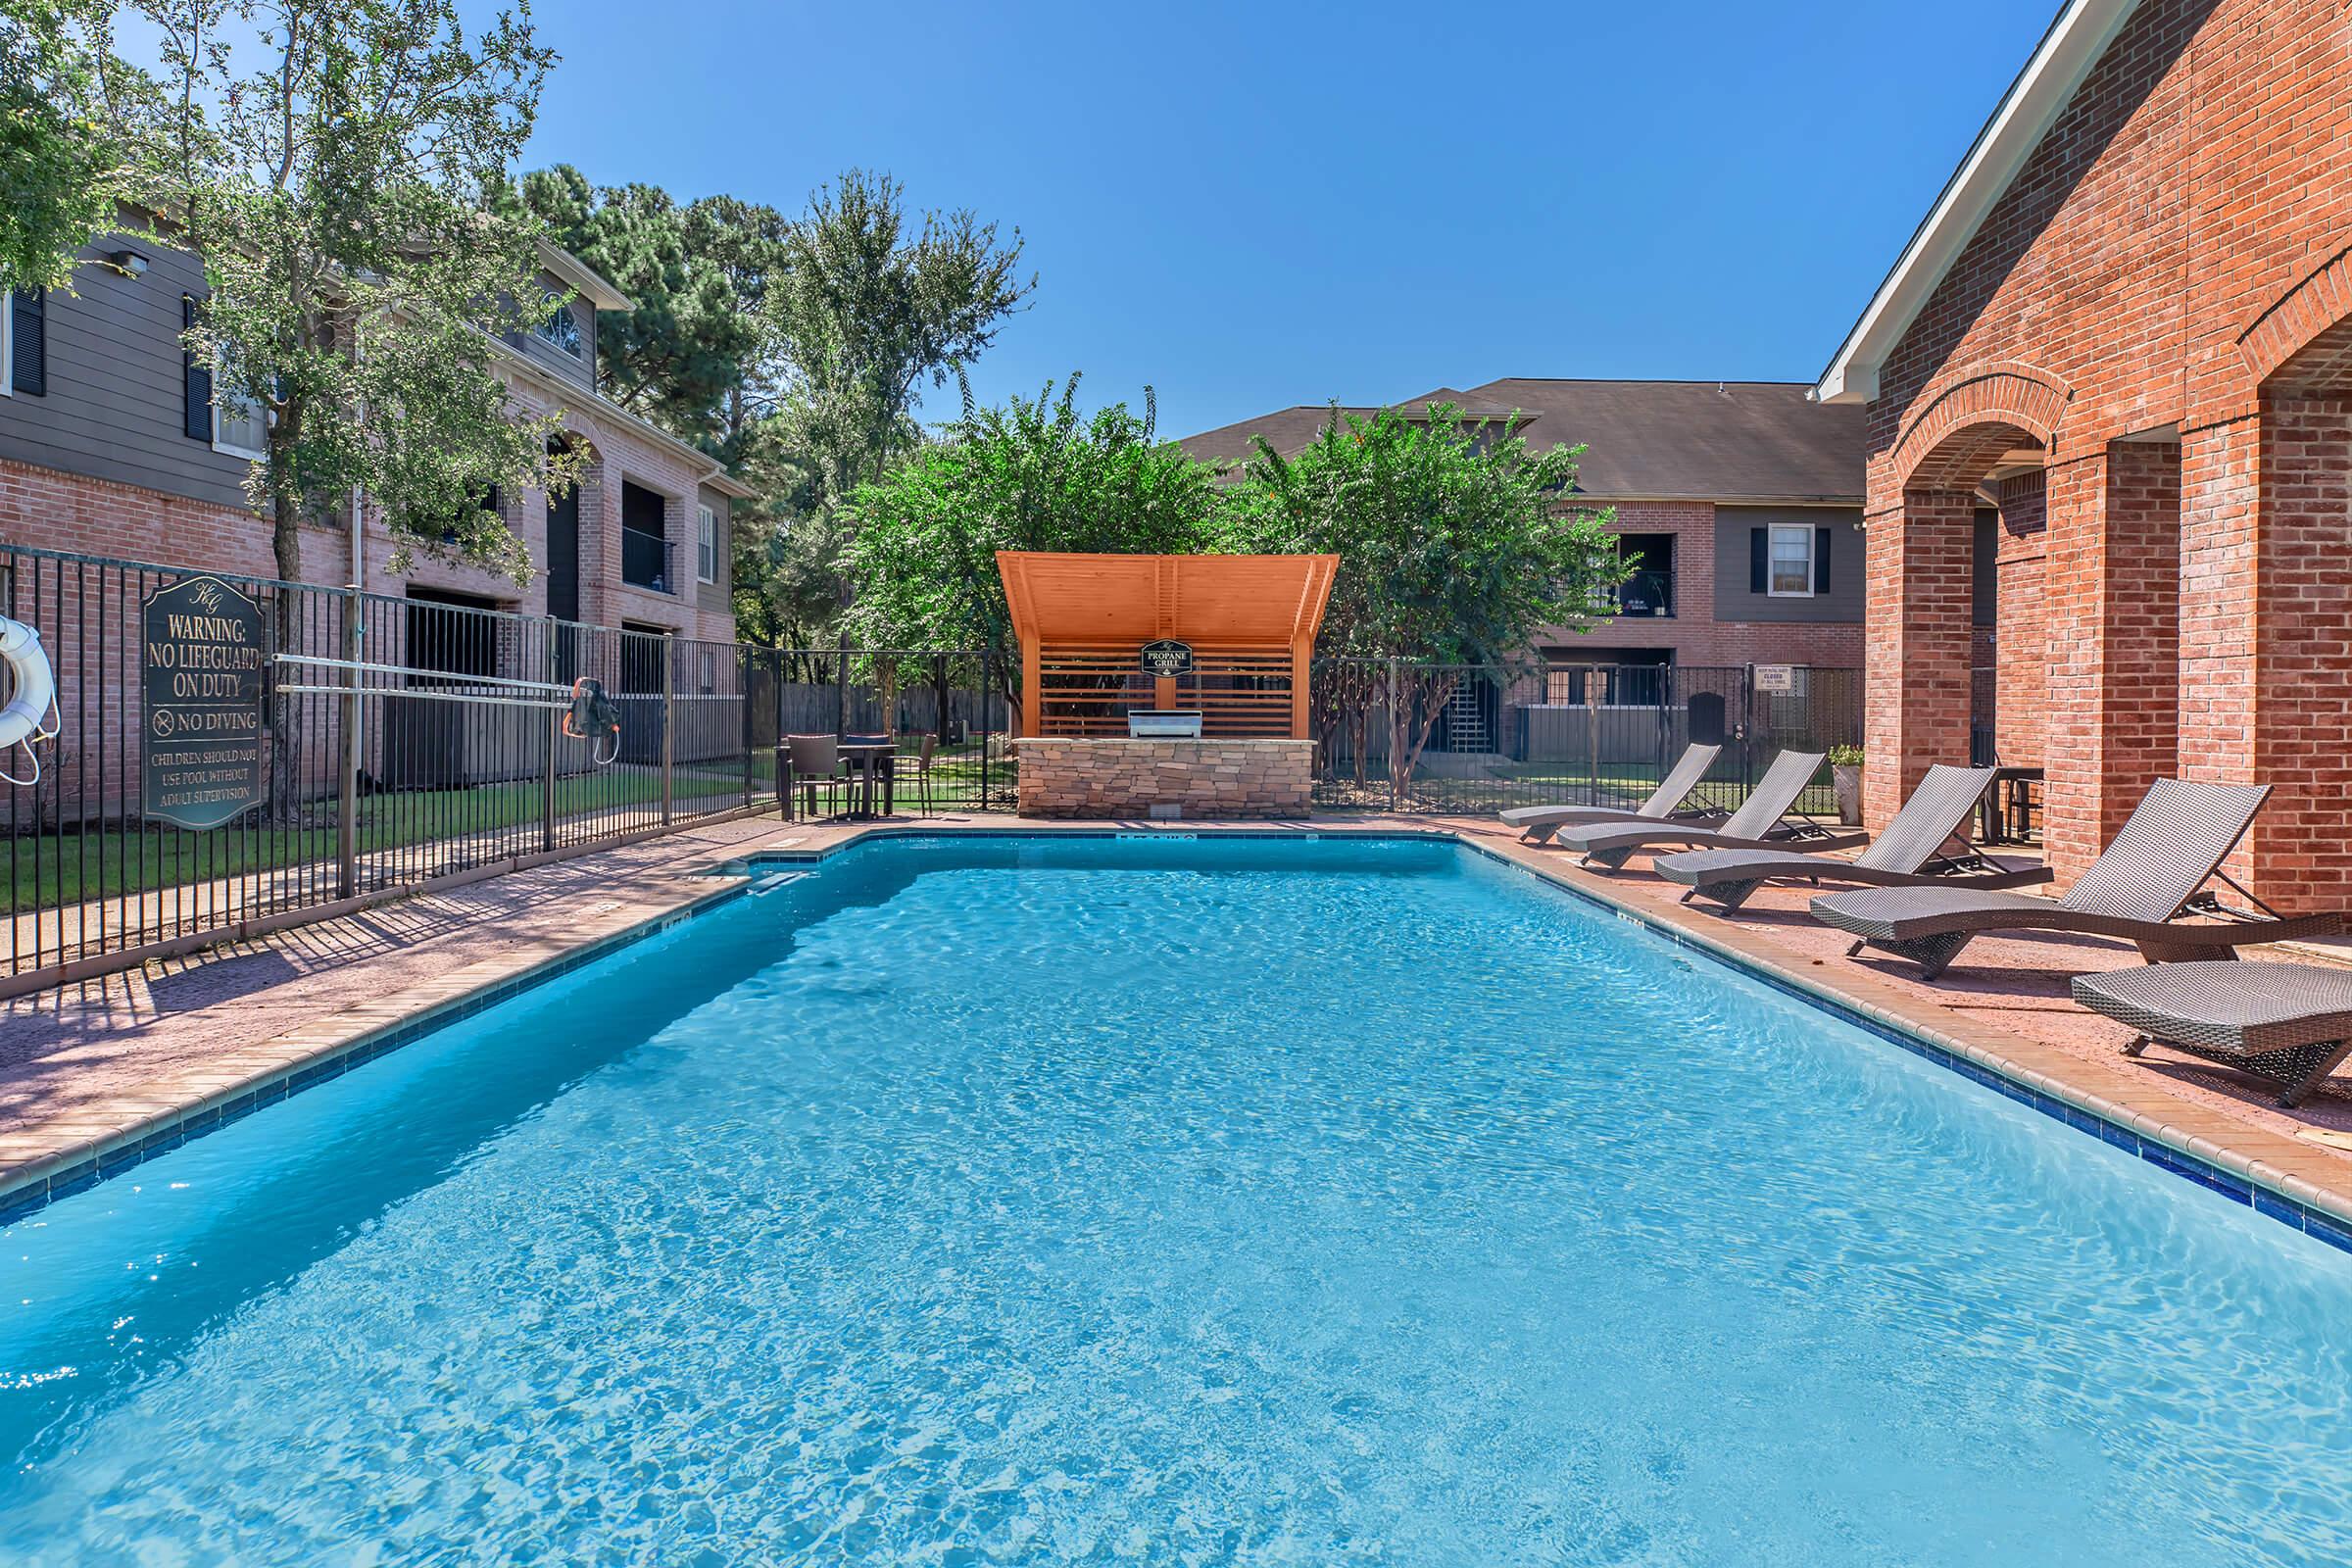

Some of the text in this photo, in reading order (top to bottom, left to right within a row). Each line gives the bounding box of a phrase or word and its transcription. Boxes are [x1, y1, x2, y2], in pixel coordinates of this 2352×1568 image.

[168, 613, 246, 643] WARNING:
[149, 642, 260, 670] NO LIFEGUARD
[173, 672, 241, 698] ON DUTY
[177, 711, 257, 731] NO DIVING
[151, 749, 257, 767] CHILDREN SHOULD NOT
[163, 767, 249, 787] USE POOL WITHOUT
[160, 786, 251, 808] ADULT SUPERVISION
